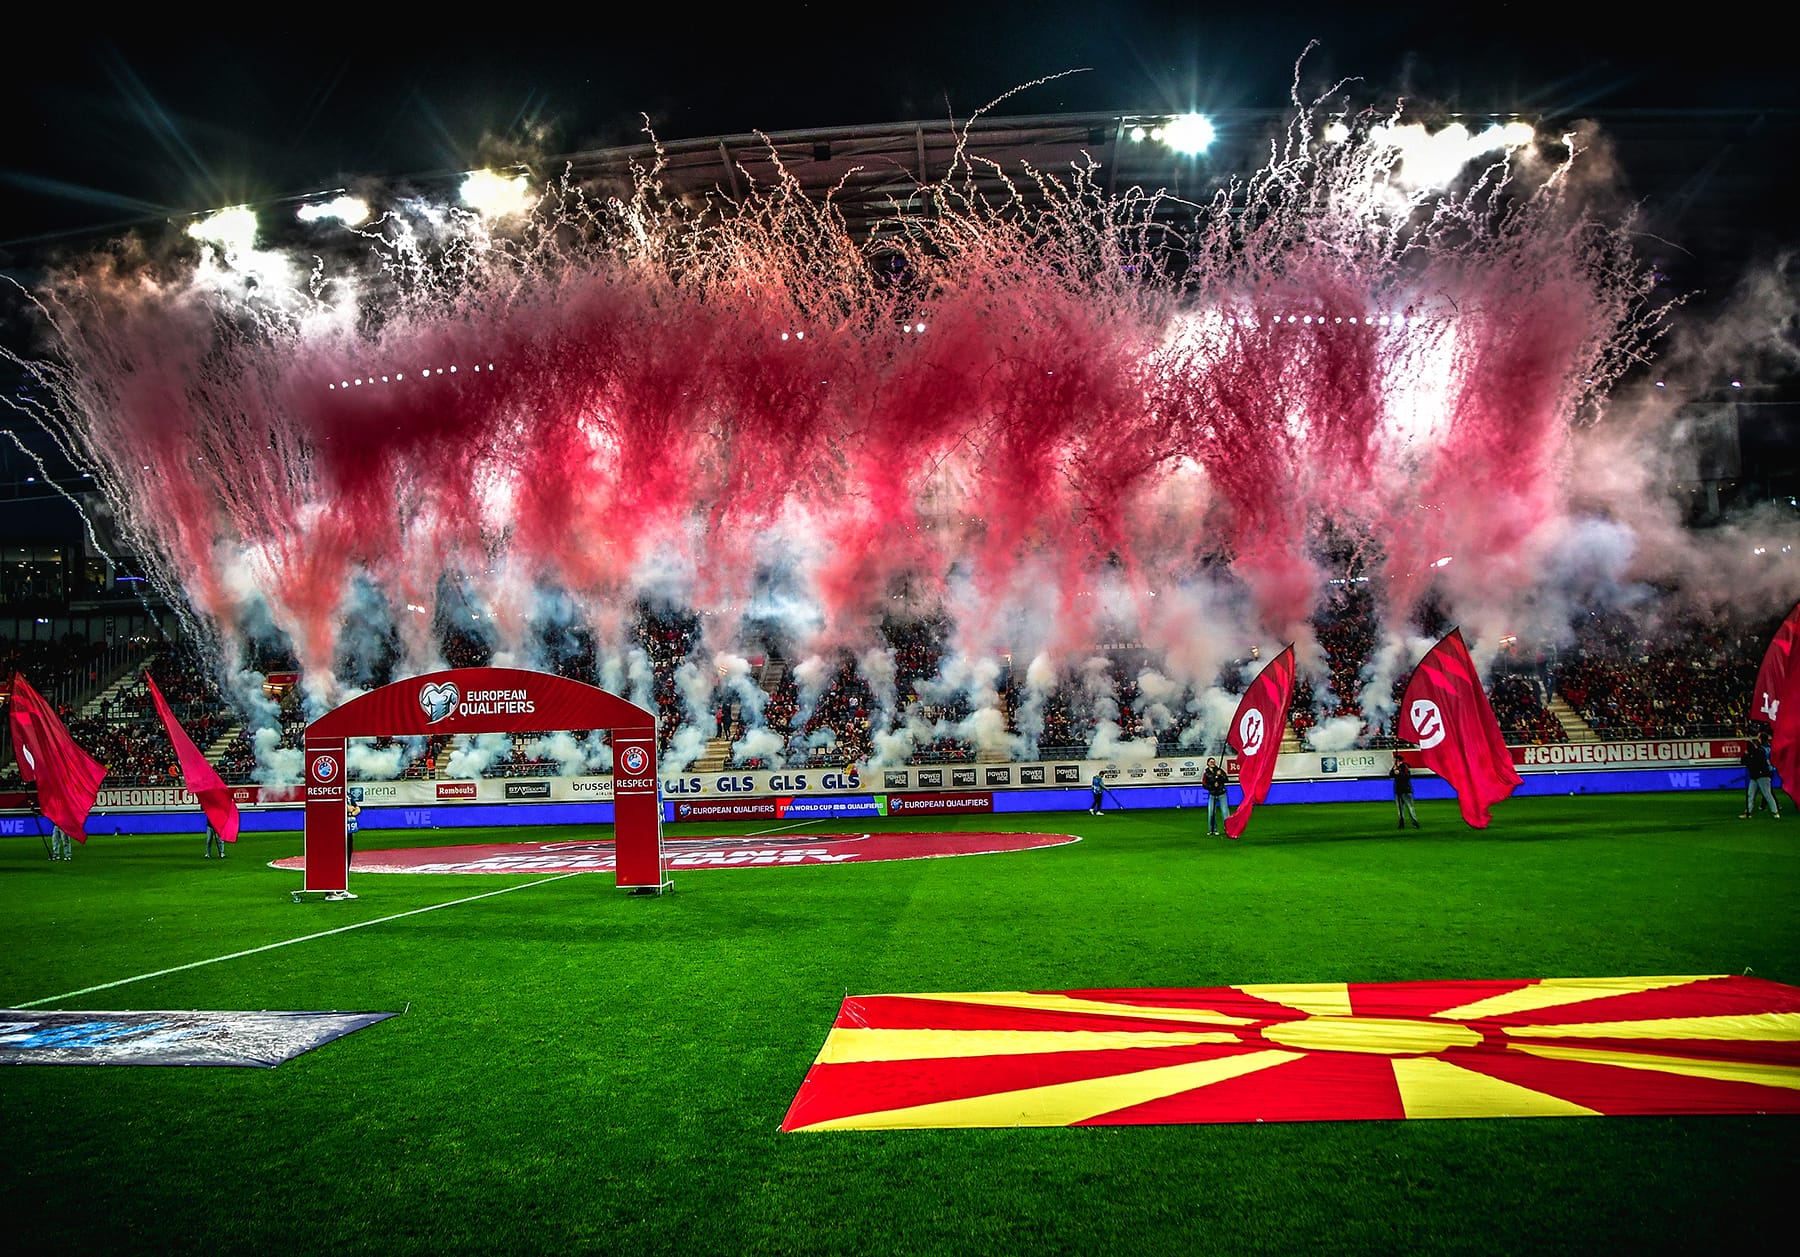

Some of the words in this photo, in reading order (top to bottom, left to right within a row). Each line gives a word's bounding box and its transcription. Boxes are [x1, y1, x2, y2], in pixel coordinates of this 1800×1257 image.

[466, 689, 527, 702] EUROPEAN
[459, 700, 536, 717] QUALIFIERS
[1524, 742, 1711, 764] #COMEONBELGIUM
[1338, 755, 1375, 766] arena
[616, 779, 654, 788] RESPECT
[1668, 772, 1701, 788] WE
[307, 786, 343, 796] RESPECT
[365, 786, 397, 796] arena
[572, 781, 613, 791] brussel
[904, 800, 945, 809] EUROPEAN
[946, 798, 989, 807] QUALIFIERS
[692, 806, 732, 815] EUROPEAN
[733, 805, 775, 814] QUALIFIERS
[404, 810, 431, 825] WE
